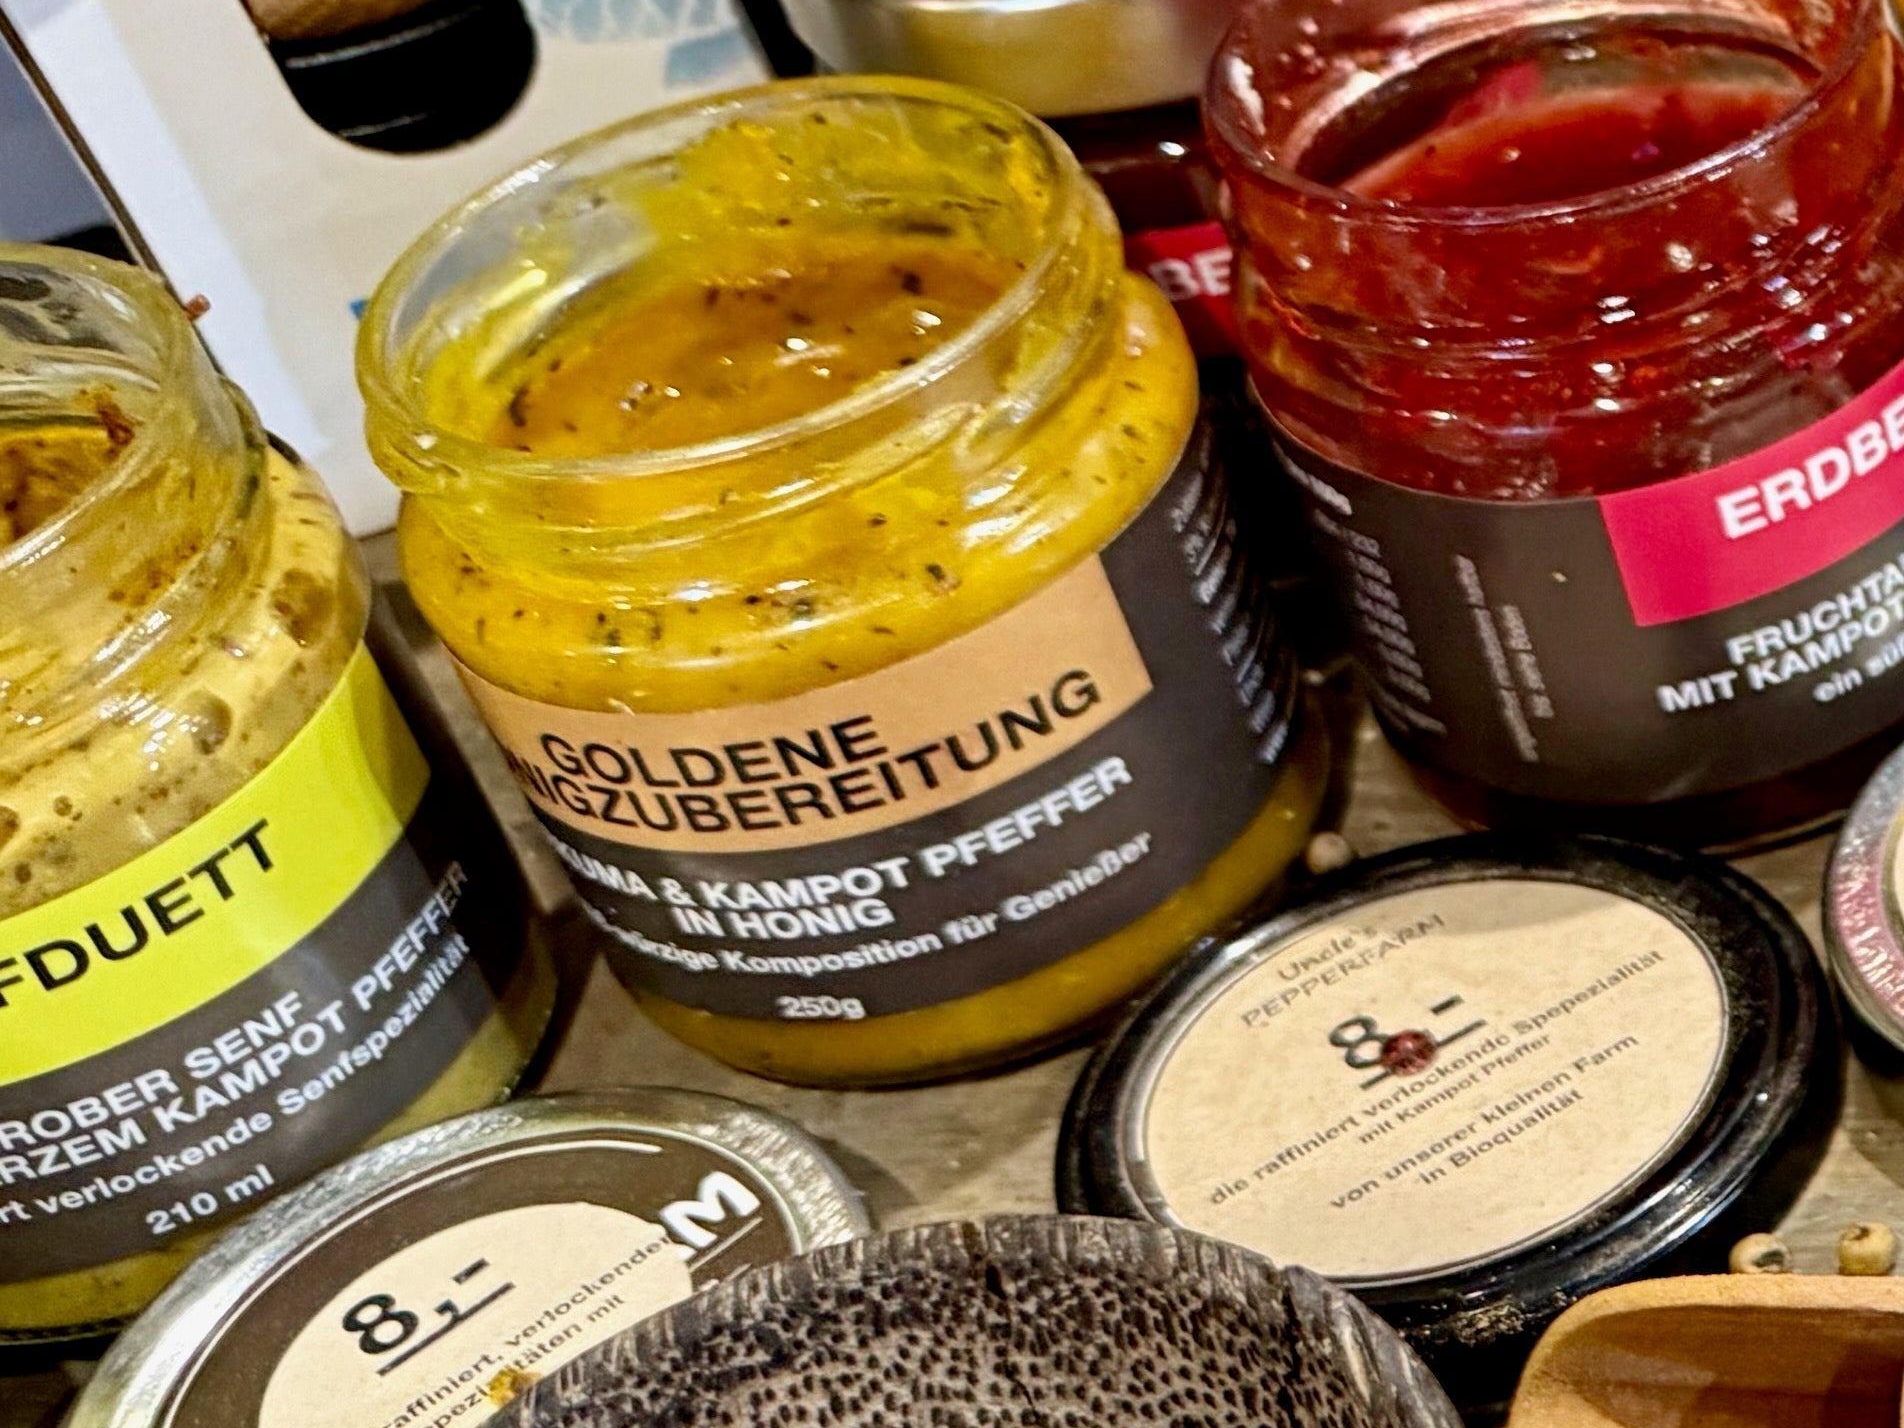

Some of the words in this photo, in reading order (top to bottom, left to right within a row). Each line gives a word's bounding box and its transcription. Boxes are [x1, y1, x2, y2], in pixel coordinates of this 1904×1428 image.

[1657, 671, 1738, 714] MIT
[1813, 673, 1863, 705] ein
[539, 712, 893, 792] GOLDENE
[657, 876, 698, 907] &
[697, 856, 911, 913] KAMPOT
[923, 755, 1133, 880] PFEFFER
[671, 905, 726, 937] IN
[726, 897, 896, 945] HONIG
[718, 930, 943, 980] Komposition
[943, 909, 999, 948] für
[1000, 831, 1155, 923] Genießer
[156, 999, 346, 1135] KAMPOT
[351, 860, 469, 1012] PFEFFER
[775, 993, 867, 1024] 250g
[1240, 912, 1446, 1028] PEPPERFARM
[34, 1113, 275, 1214] verlockende
[277, 932, 471, 1116] Senfspezialität
[184, 991, 308, 1076] SENF
[1210, 1176, 1251, 1206] die
[1253, 1114, 1361, 1183] raffiniert
[1362, 1034, 1512, 1121] verlockende
[1329, 1179, 1381, 1211] von
[1383, 1122, 1480, 1181] unserer
[1480, 1072, 1573, 1126] kleinen
[1573, 1034, 1641, 1076] Farm
[1358, 1119, 1396, 1146] mit
[1396, 1068, 1483, 1126] Kampot
[1416, 1162, 1447, 1186] in
[1448, 1087, 1586, 1168] Bioqualität
[145, 1191, 220, 1237] 210
[225, 1163, 278, 1205] ml
[586, 1292, 627, 1326] mit
